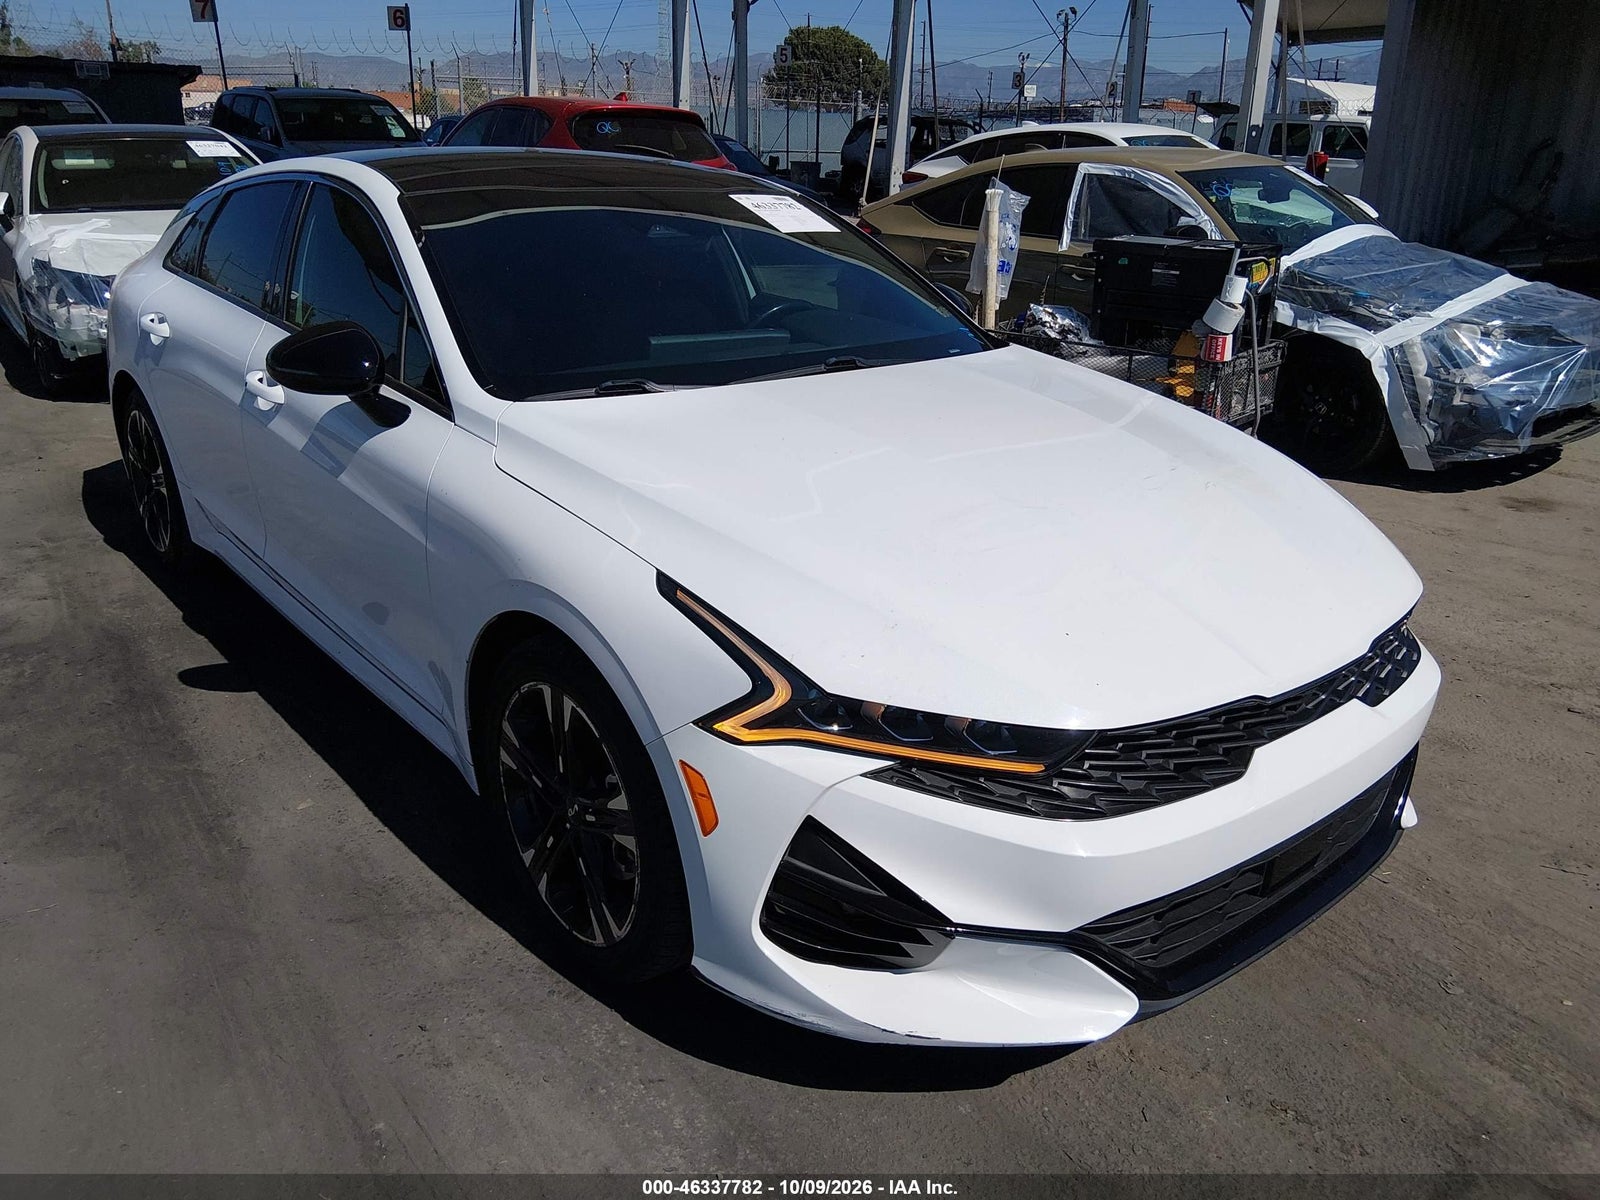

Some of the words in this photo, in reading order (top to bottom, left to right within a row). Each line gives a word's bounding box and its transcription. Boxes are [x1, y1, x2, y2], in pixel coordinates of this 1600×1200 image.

[195, 0, 210, 19] 7
[393, 9, 406, 28] 6
[780, 47, 788, 63] 5
[1015, 75, 1022, 88] 3
[1109, 84, 1115, 96] 2
